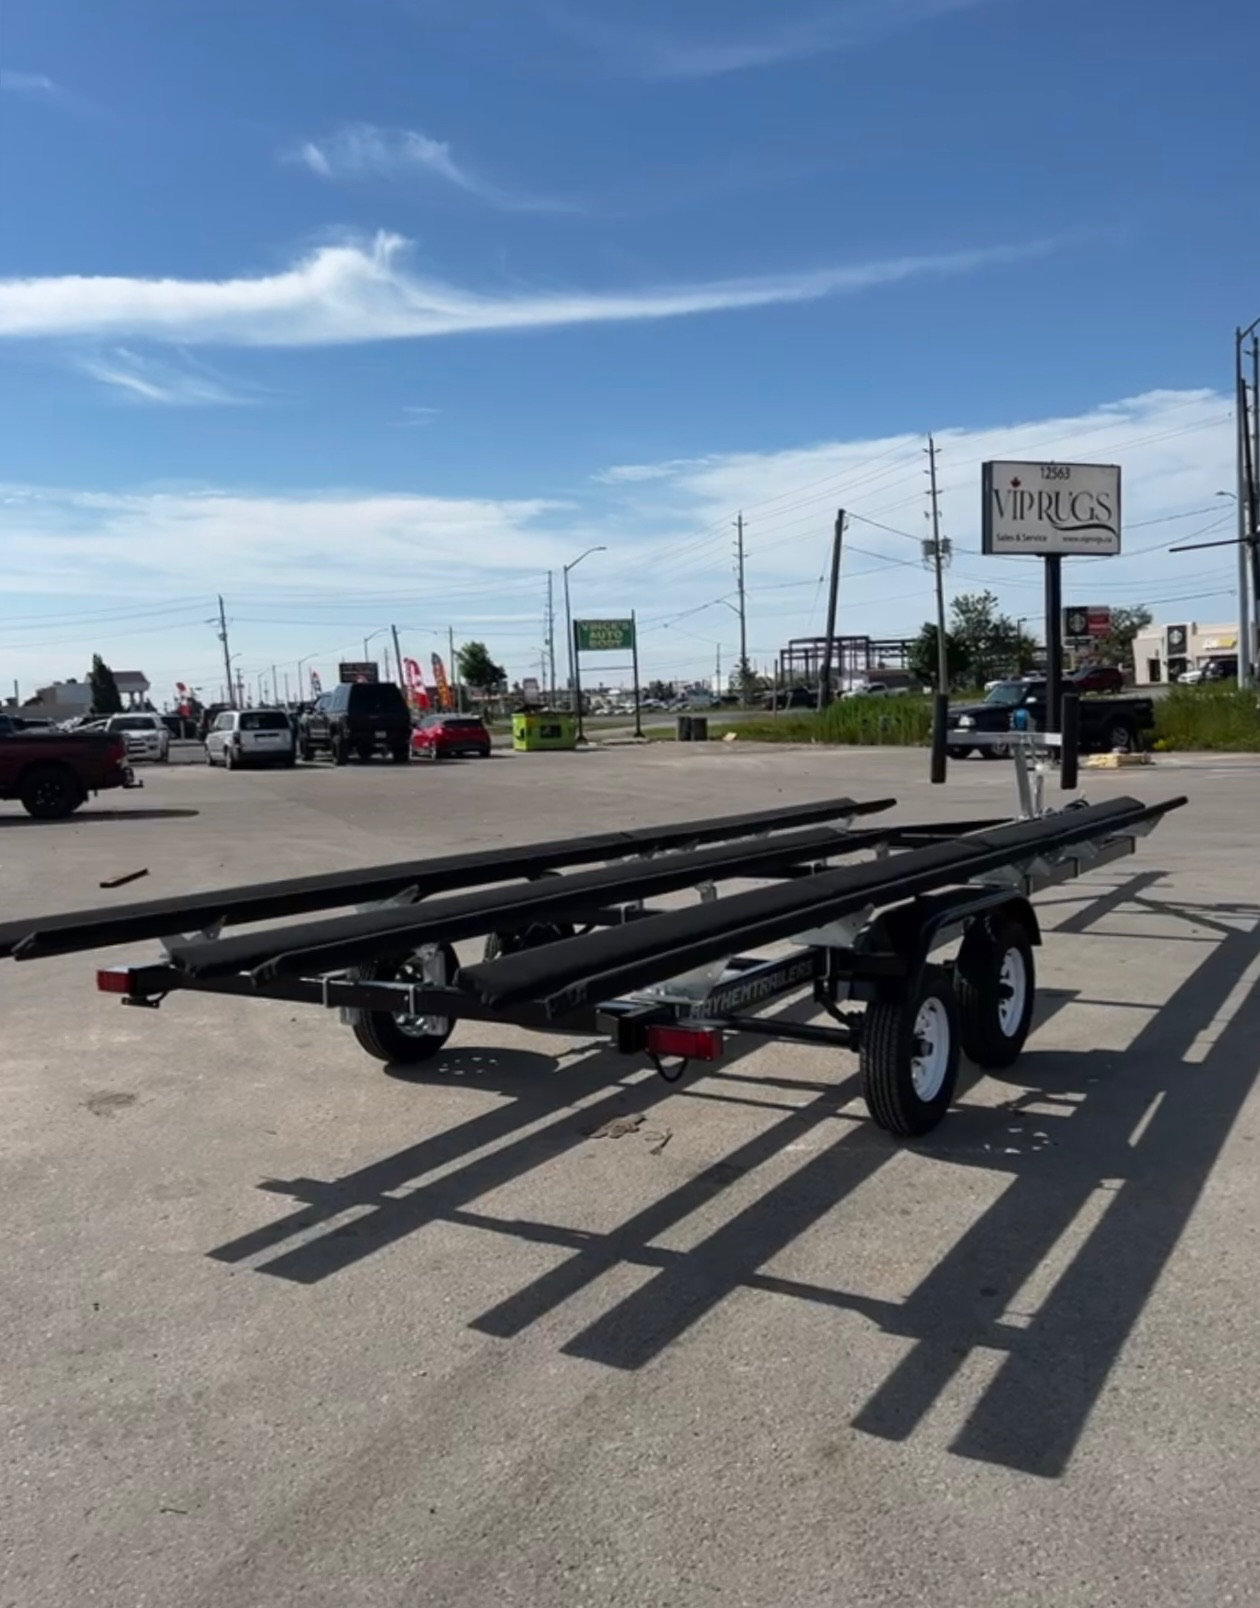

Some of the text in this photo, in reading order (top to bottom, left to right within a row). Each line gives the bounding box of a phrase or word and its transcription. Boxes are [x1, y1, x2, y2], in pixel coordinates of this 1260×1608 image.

[1041, 466, 1070, 480] 12563
[997, 533, 1014, 542] Sales
[1022, 533, 1047, 542] Service
[589, 631, 623, 640] AUTO
